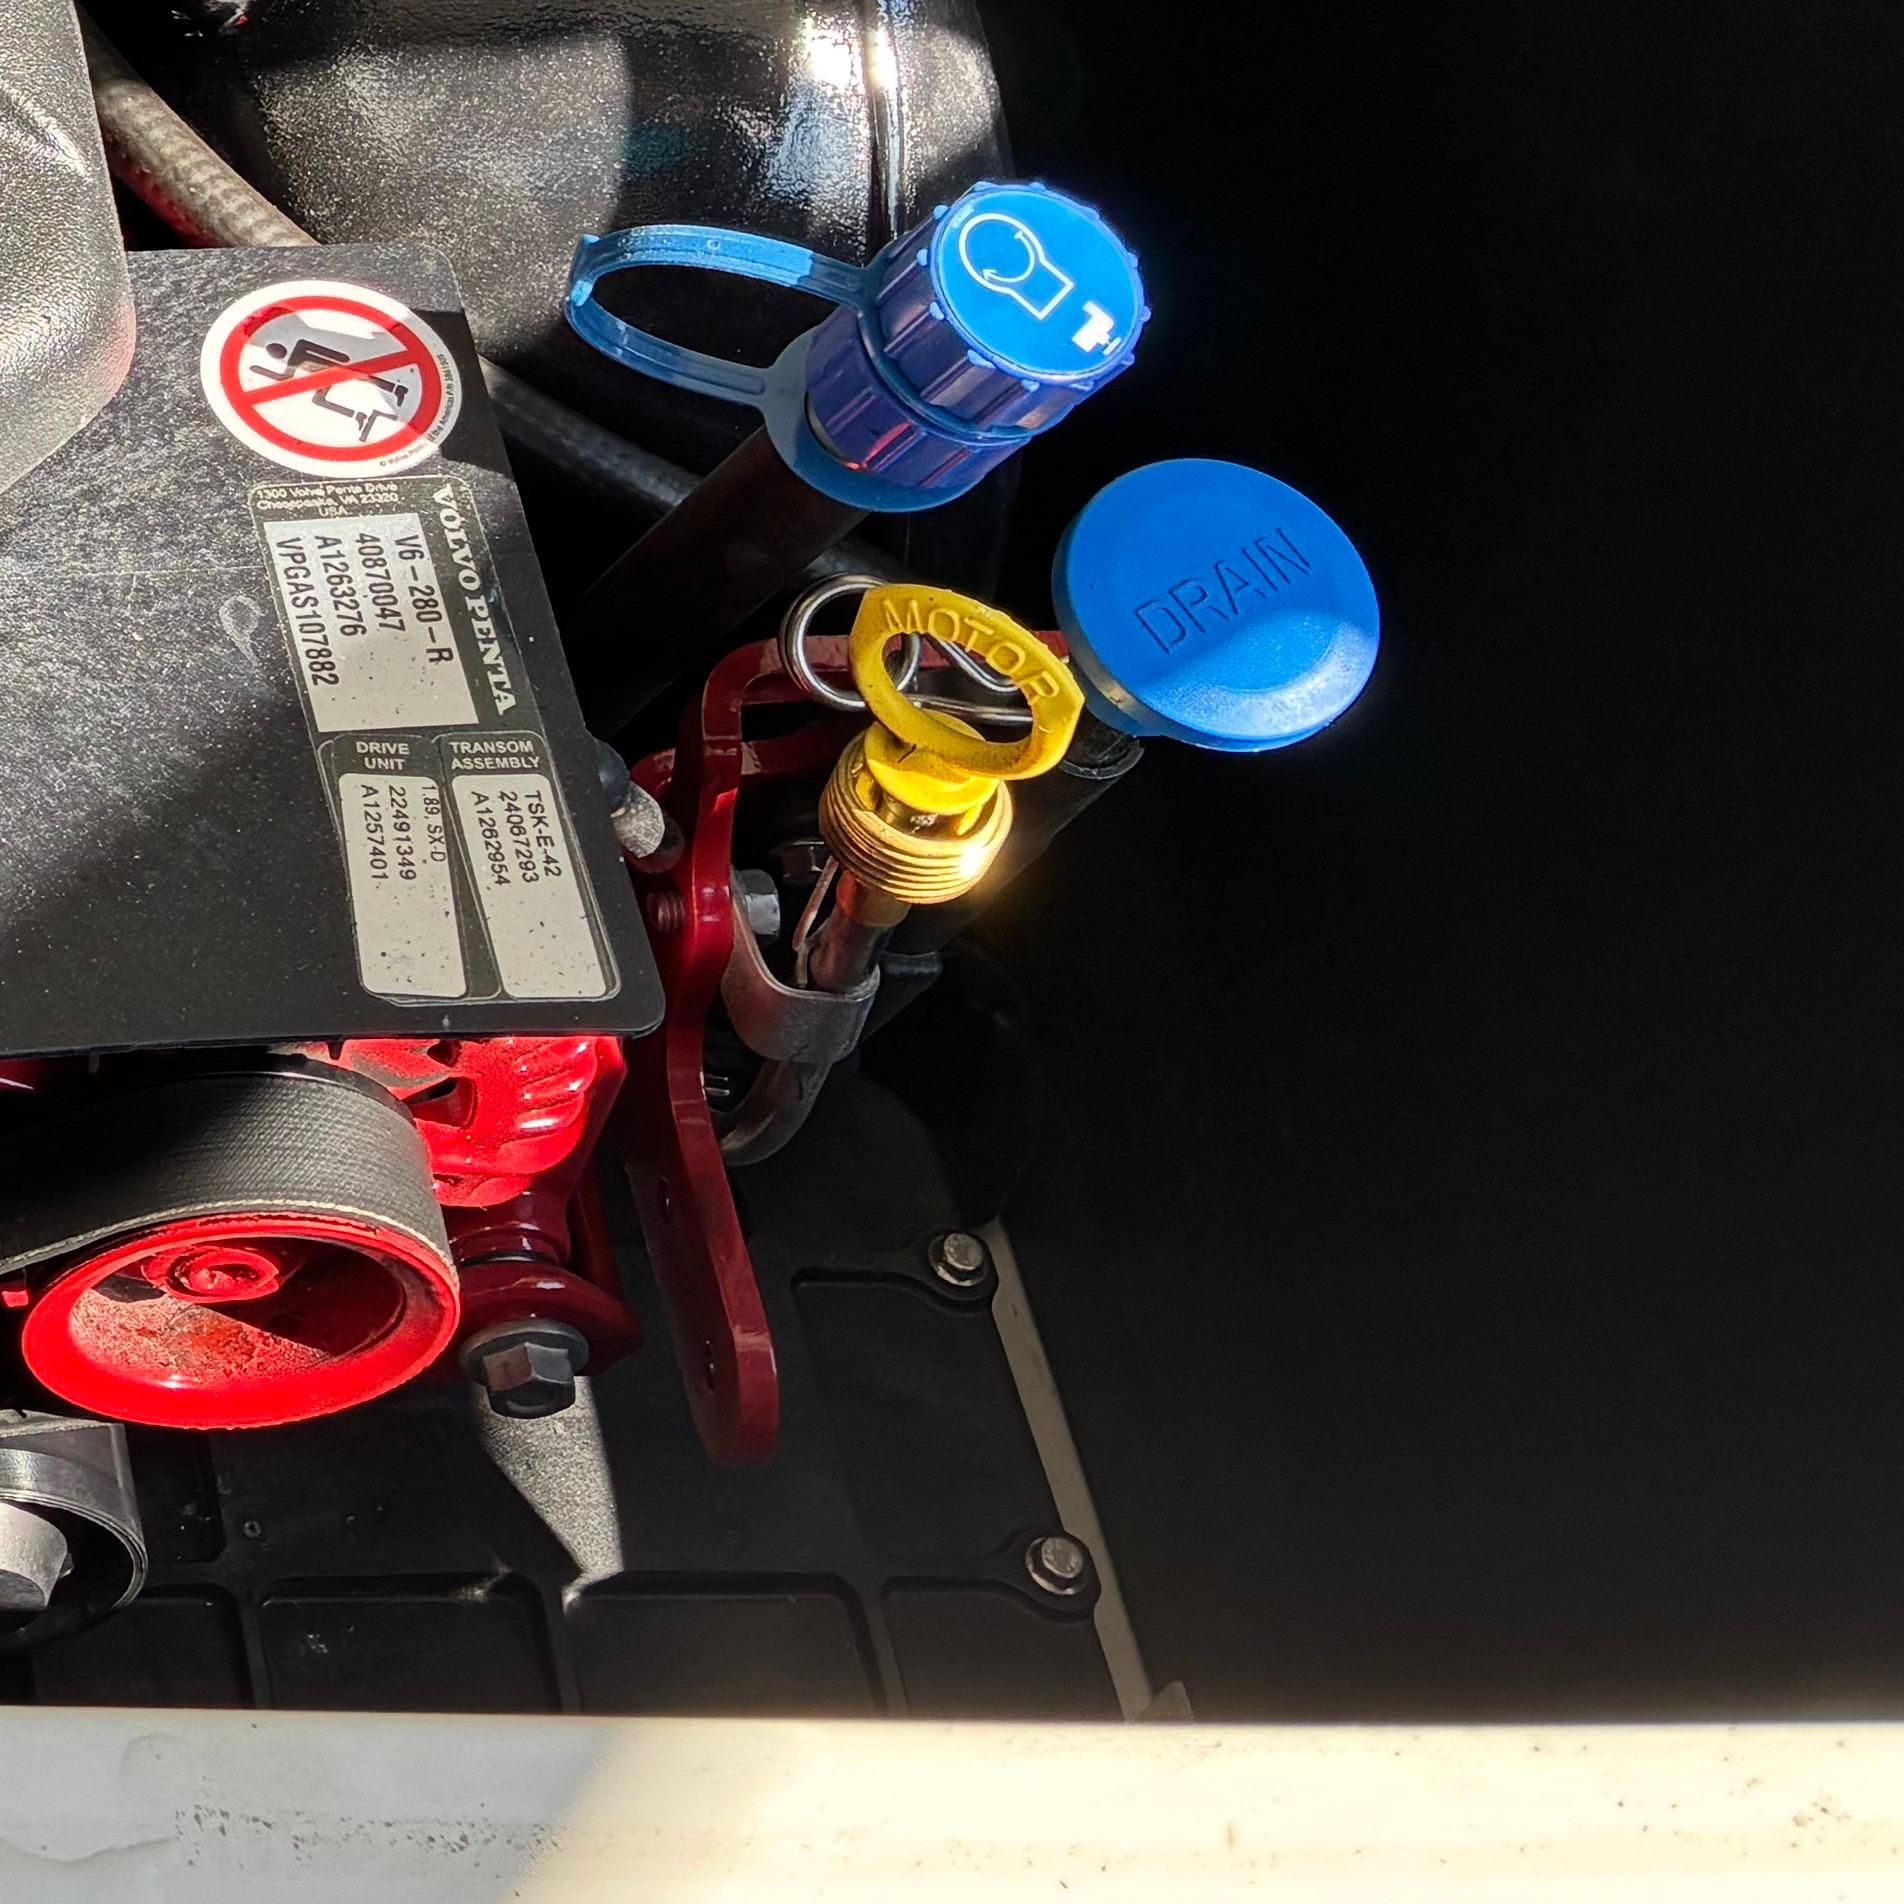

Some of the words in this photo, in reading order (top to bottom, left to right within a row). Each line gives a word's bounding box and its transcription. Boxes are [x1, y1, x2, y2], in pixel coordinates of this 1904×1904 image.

[257, 488, 286, 499] 1300
[326, 484, 363, 496] Penta
[365, 482, 398, 493] Drive
[319, 506, 347, 516] USA
[276, 537, 340, 686] VPGAS107882
[315, 536, 367, 636] A1263276
[355, 533, 406, 632] 40870047
[394, 534, 454, 663] V6-280-R
[434, 484, 481, 591] VOLVO
[465, 595, 516, 715] PENTA
[1130, 524, 1316, 658] DRAIN
[879, 595, 1063, 703] MOTOR
[356, 742, 410, 755] DRIVE
[364, 757, 405, 770] UNIT
[449, 740, 534, 753] TRANSOM
[451, 756, 540, 769] ASSEMBLY
[361, 784, 389, 881] A1257401
[389, 784, 417, 881] 22491349
[427, 824, 446, 862] SX-D
[471, 791, 511, 886] A1262954
[500, 791, 540, 883] 24067293
[524, 790, 562, 877] TSK-E-42
